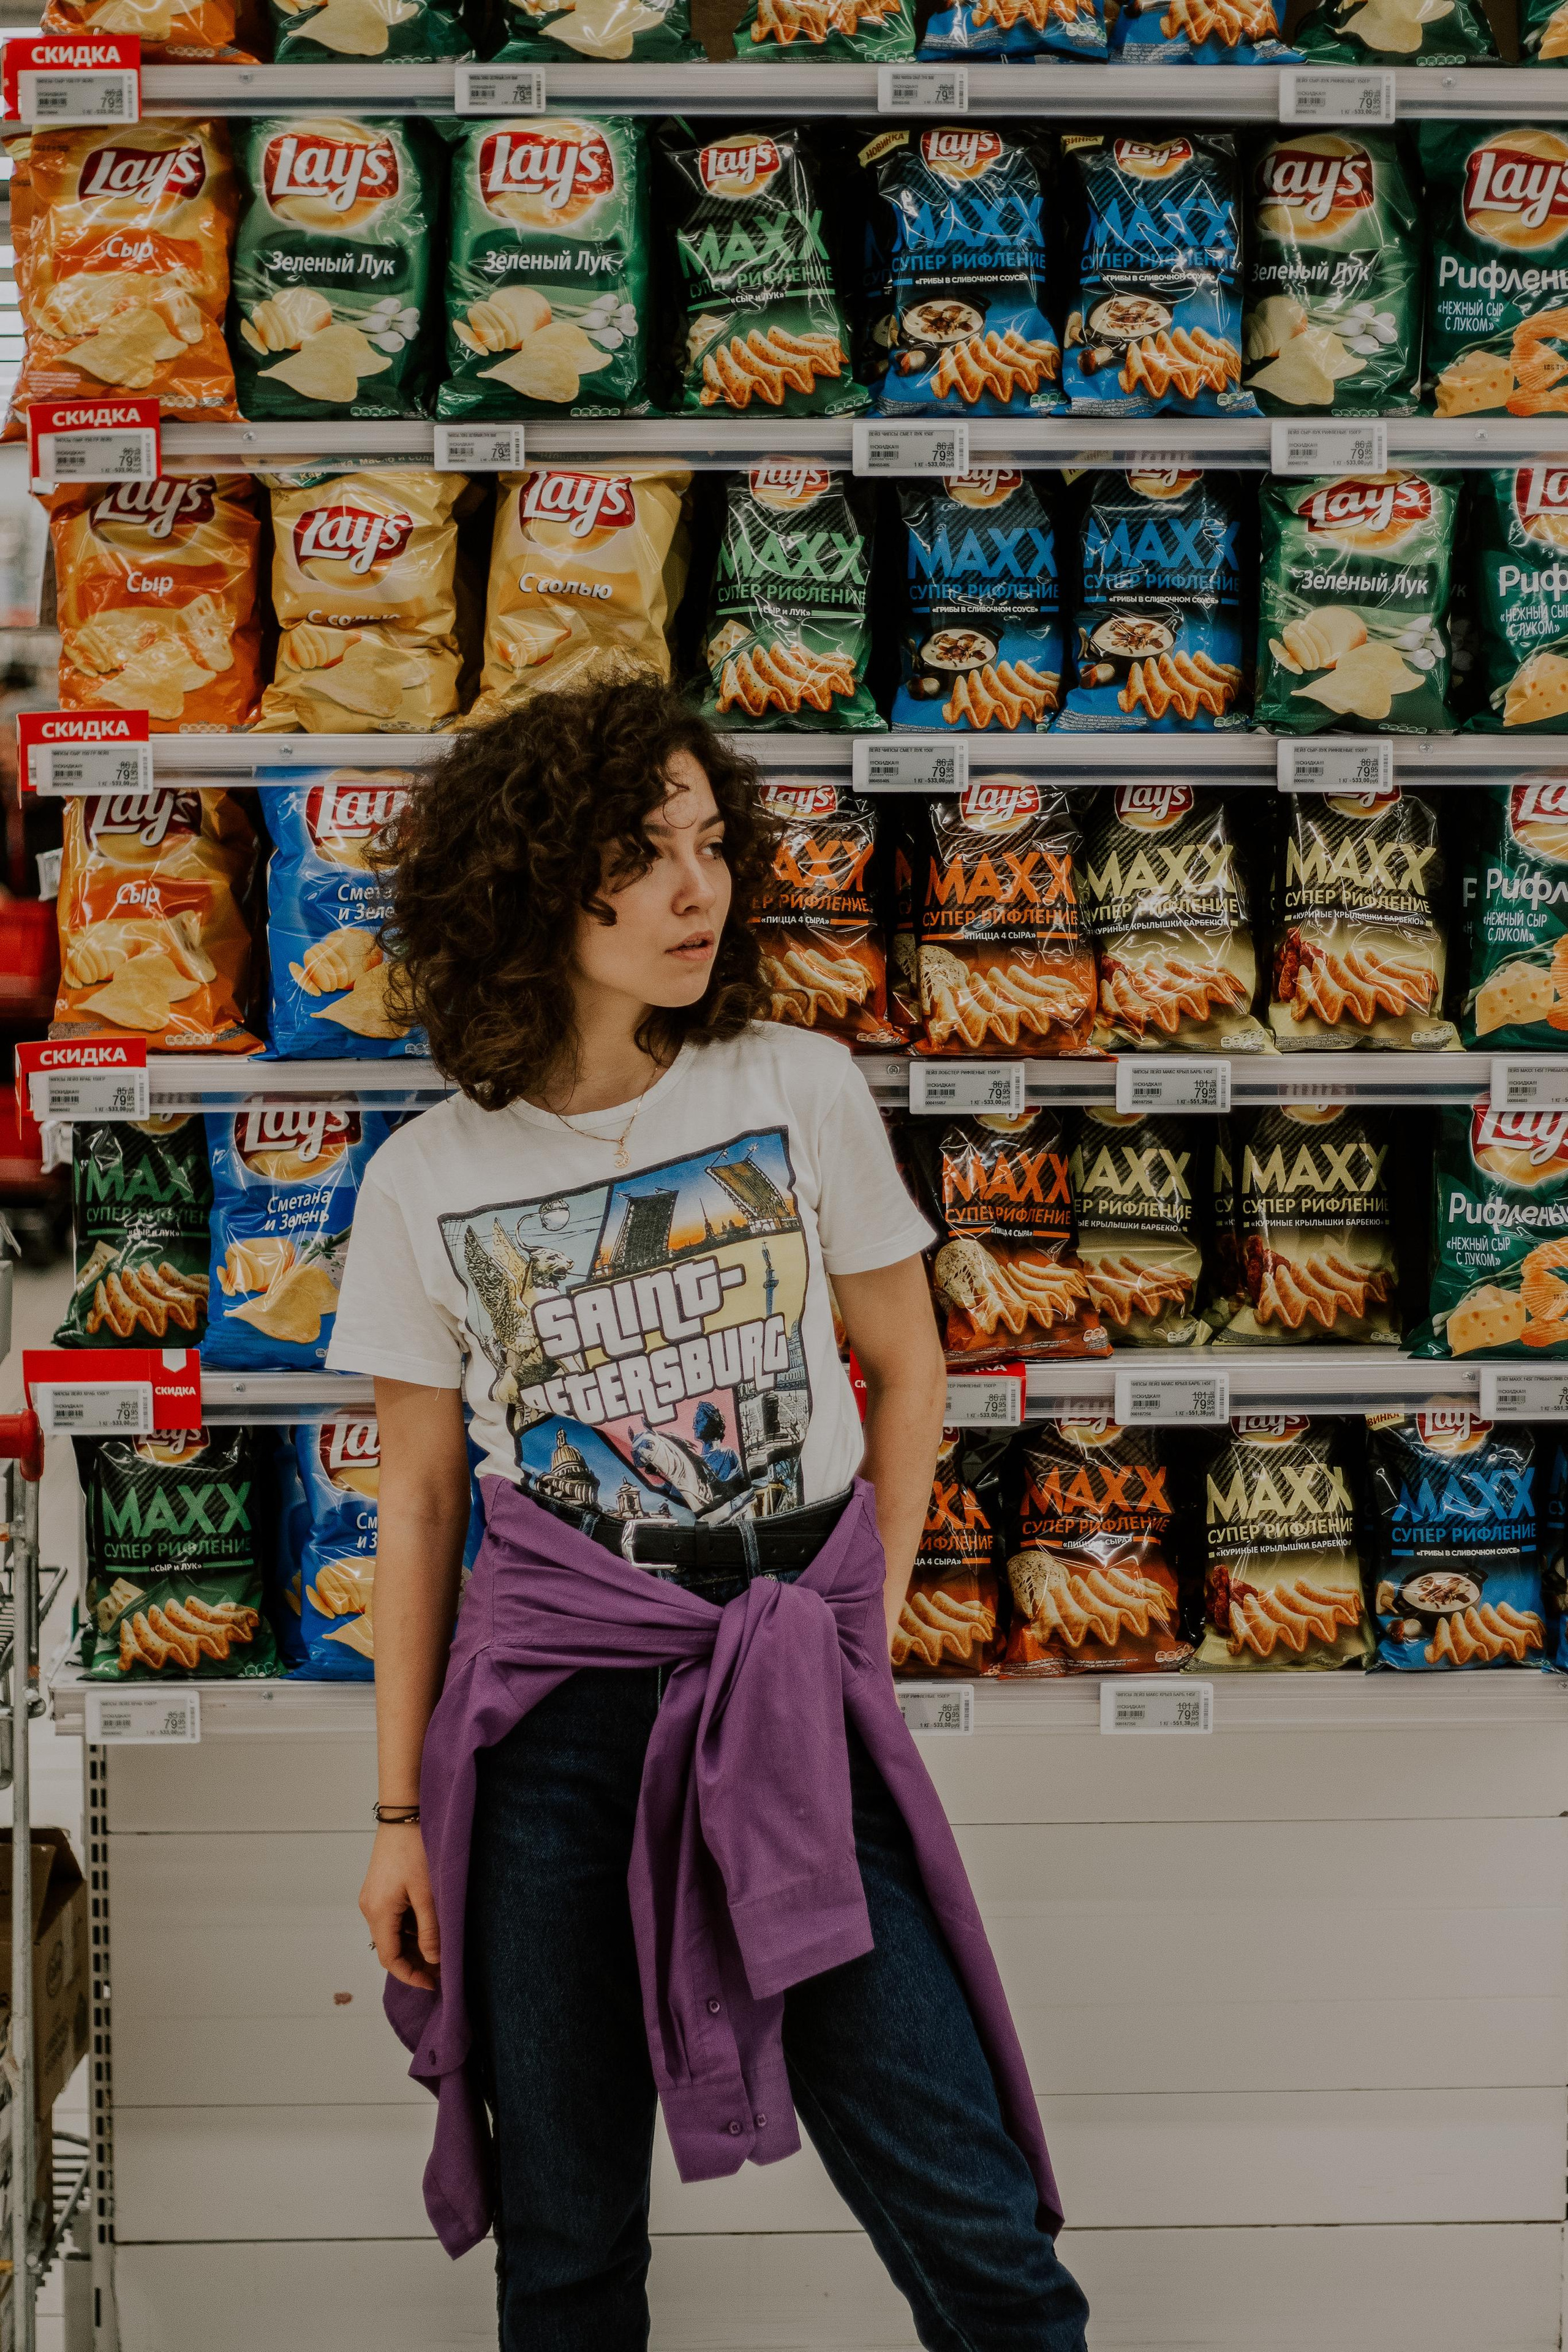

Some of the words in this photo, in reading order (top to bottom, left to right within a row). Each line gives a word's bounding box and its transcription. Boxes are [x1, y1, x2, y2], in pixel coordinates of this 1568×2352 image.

[31, 45, 121, 67] СКИДКА
[1359, 98, 1373, 108] 79
[865, 133, 905, 159] НОВИНКА
[892, 197, 1045, 252] MAXX
[1082, 198, 1236, 252] MAXX
[106, 236, 153, 259] Сыр
[677, 210, 831, 276] MAXX
[268, 251, 354, 274] Зеленый
[356, 253, 395, 275] Лук
[484, 250, 571, 271] Зеленый
[576, 251, 612, 273] Лук
[892, 254, 946, 272] СУПЕР
[952, 252, 1046, 270] РИФЛЕНИЕ
[1251, 262, 1329, 282] Зеленый
[1332, 264, 1370, 283] Лук
[1438, 300, 1483, 317] «НЕЖНЫЙ
[1486, 302, 1504, 317] СЫР
[1445, 317, 1451, 331] С
[1453, 317, 1494, 332] ЛУКОМ»
[52, 407, 141, 427] СКИДКА
[932, 451, 946, 461] 79
[1351, 449, 1364, 459] 79
[907, 527, 1058, 581] MAXX
[1082, 518, 1240, 571] MAXX
[717, 527, 866, 584] MAXX
[126, 572, 173, 597] Сыр
[519, 573, 535, 593] С
[537, 573, 613, 601] солью
[910, 583, 962, 600] СУПЕР
[967, 583, 1059, 600] РИФЛЕНИЕ
[1146, 574, 1240, 593] РИФЛЕНИЕ
[1301, 568, 1389, 594] Зеленый
[1390, 573, 1429, 596] Лук
[718, 585, 763, 603] СУПЕР
[766, 584, 867, 606] РИФЛЕНИЕ
[967, 605, 1010, 613] СЛИВОЧНОМ
[1011, 605, 1039, 613] СОУСЕ»
[42, 720, 130, 741] СКИДКА
[116, 769, 130, 780] 79
[932, 767, 946, 777] 79
[1357, 767, 1370, 777] 79
[1087, 843, 1237, 902] MAXX
[1286, 836, 1436, 896] MAXX
[925, 851, 1076, 906] MAXX
[116, 881, 160, 906] Сыр
[1286, 890, 1336, 908] СУПЕР
[1341, 890, 1431, 914] РИФЛЕНИЕ
[761, 916, 796, 924] «ПИЦЦА
[805, 916, 829, 925] СЫРА»
[922, 911, 974, 927] СУПЕР
[981, 910, 1077, 926] РИФЛЕНИЕ
[1292, 910, 1333, 919] «КУРИНЫЕ
[1335, 910, 1383, 922] КРЫЛЫШКИ
[1527, 912, 1547, 929] СЫР
[964, 932, 998, 941] «ПИЦЦА
[1008, 931, 1036, 940] СЫРА»
[1495, 927, 1534, 943] ЛУКОМ»
[40, 1047, 127, 1066] СКИДКА
[113, 1095, 126, 1105] 79
[989, 1088, 1001, 1099] 79
[1195, 1088, 1208, 1098] 79
[942, 1150, 1071, 1204] MAXX
[1242, 1144, 1389, 1194] MAXX
[266, 1189, 331, 1216] Сметана
[1098, 1199, 1192, 1220] РИФЛЕНИЕ
[1242, 1199, 1297, 1215] СУПЕР
[1301, 1198, 1389, 1213] РИФЛЕНИЕ
[264, 1218, 276, 1232] и
[281, 1207, 331, 1231] Зелень
[1091, 1220, 1139, 1230] КРЫЛЫШКИ
[1251, 1218, 1294, 1227] «КУРИНЫЕ
[1295, 1218, 1344, 1227] КРЫЛЫШКИ
[1345, 1218, 1384, 1226] БАРБЕКЮ»
[1446, 1235, 1488, 1251] «НЕЖНЫЙ
[1491, 1236, 1510, 1251] СЫР
[1456, 1253, 1463, 1265] С
[1464, 1253, 1501, 1266] ЛУКОМ»
[520, 1314, 790, 1426] PETERSBURG
[155, 1386, 196, 1397] СКИДКА
[116, 1409, 130, 1420] 79
[984, 1401, 997, 1412] 79
[1193, 1400, 1207, 1410] 79
[1020, 1466, 1174, 1517] MAXX
[1206, 1464, 1353, 1525] MAXX
[1391, 1468, 1536, 1522] MAXX
[102, 1482, 252, 1537] MAXX
[1023, 1520, 1076, 1536] СУПЕР
[1079, 1517, 1170, 1534] РИФЛЕНИЕ
[1207, 1525, 1261, 1545] СУПЕР
[1265, 1517, 1353, 1541] РИФЛЕНИЕ
[1392, 1528, 1446, 1543] СУПЕР
[1452, 1524, 1536, 1542] РИФЛЕНИЕ
[104, 1544, 153, 1559] СУПЕР
[157, 1539, 252, 1556] РИФЛЕНИЕ
[1215, 1546, 1259, 1558] «КУРИНЫЕ
[1261, 1543, 1310, 1553] КРЫЛЫШКИ
[1416, 1549, 1443, 1558] «ГРИБЫ
[1452, 1548, 1495, 1557] СЛИВОЧНОМ
[150, 1562, 172, 1572] «СЫР
[181, 1561, 202, 1570] ЛУК»
[938, 1711, 951, 1722] 79
[1178, 1710, 1191, 1720] 79
